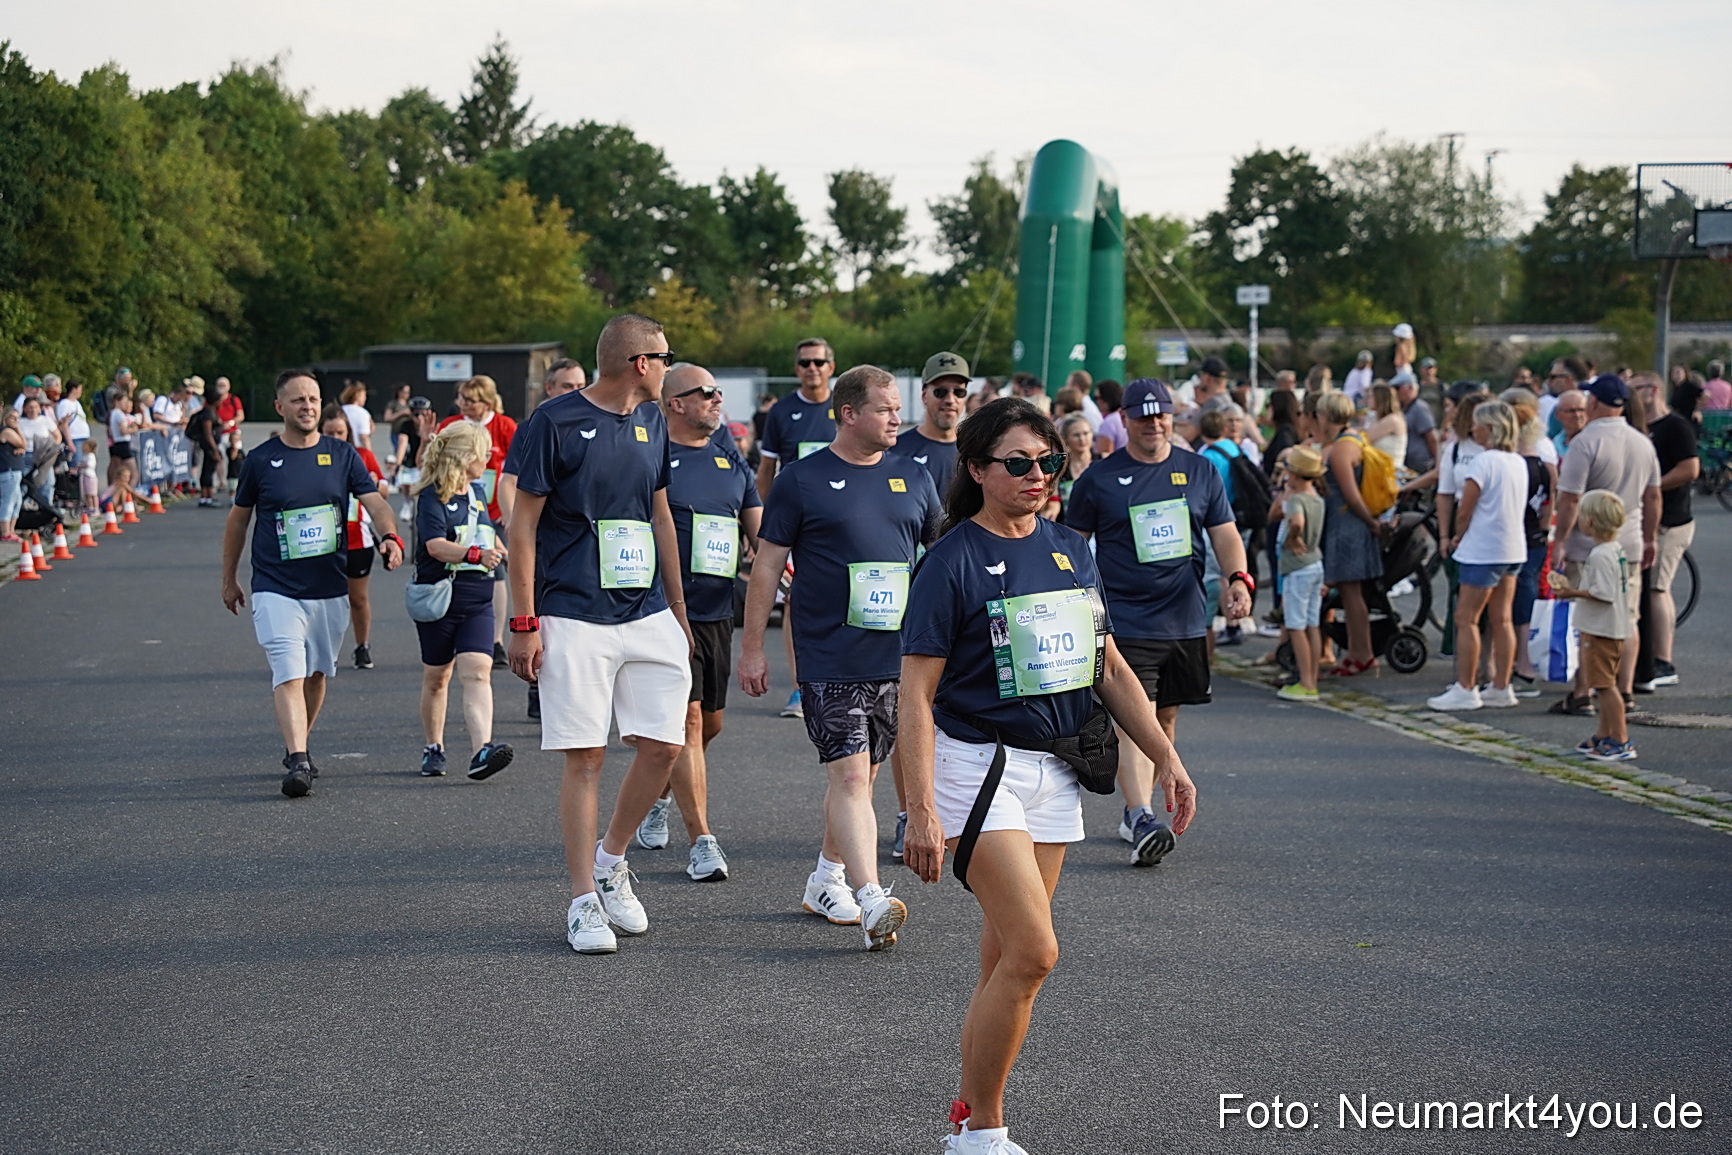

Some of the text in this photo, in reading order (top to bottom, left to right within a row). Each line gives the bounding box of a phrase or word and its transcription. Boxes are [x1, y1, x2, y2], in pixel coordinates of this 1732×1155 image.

[299, 526, 322, 538] 467
[1151, 525, 1174, 538] 451
[706, 540, 730, 554] 448
[619, 548, 644, 562] 441
[869, 590, 893, 605] 471
[1038, 632, 1075, 655] 470
[1027, 660, 1055, 671] Annett
[1055, 656, 1088, 668] Wierczoch
